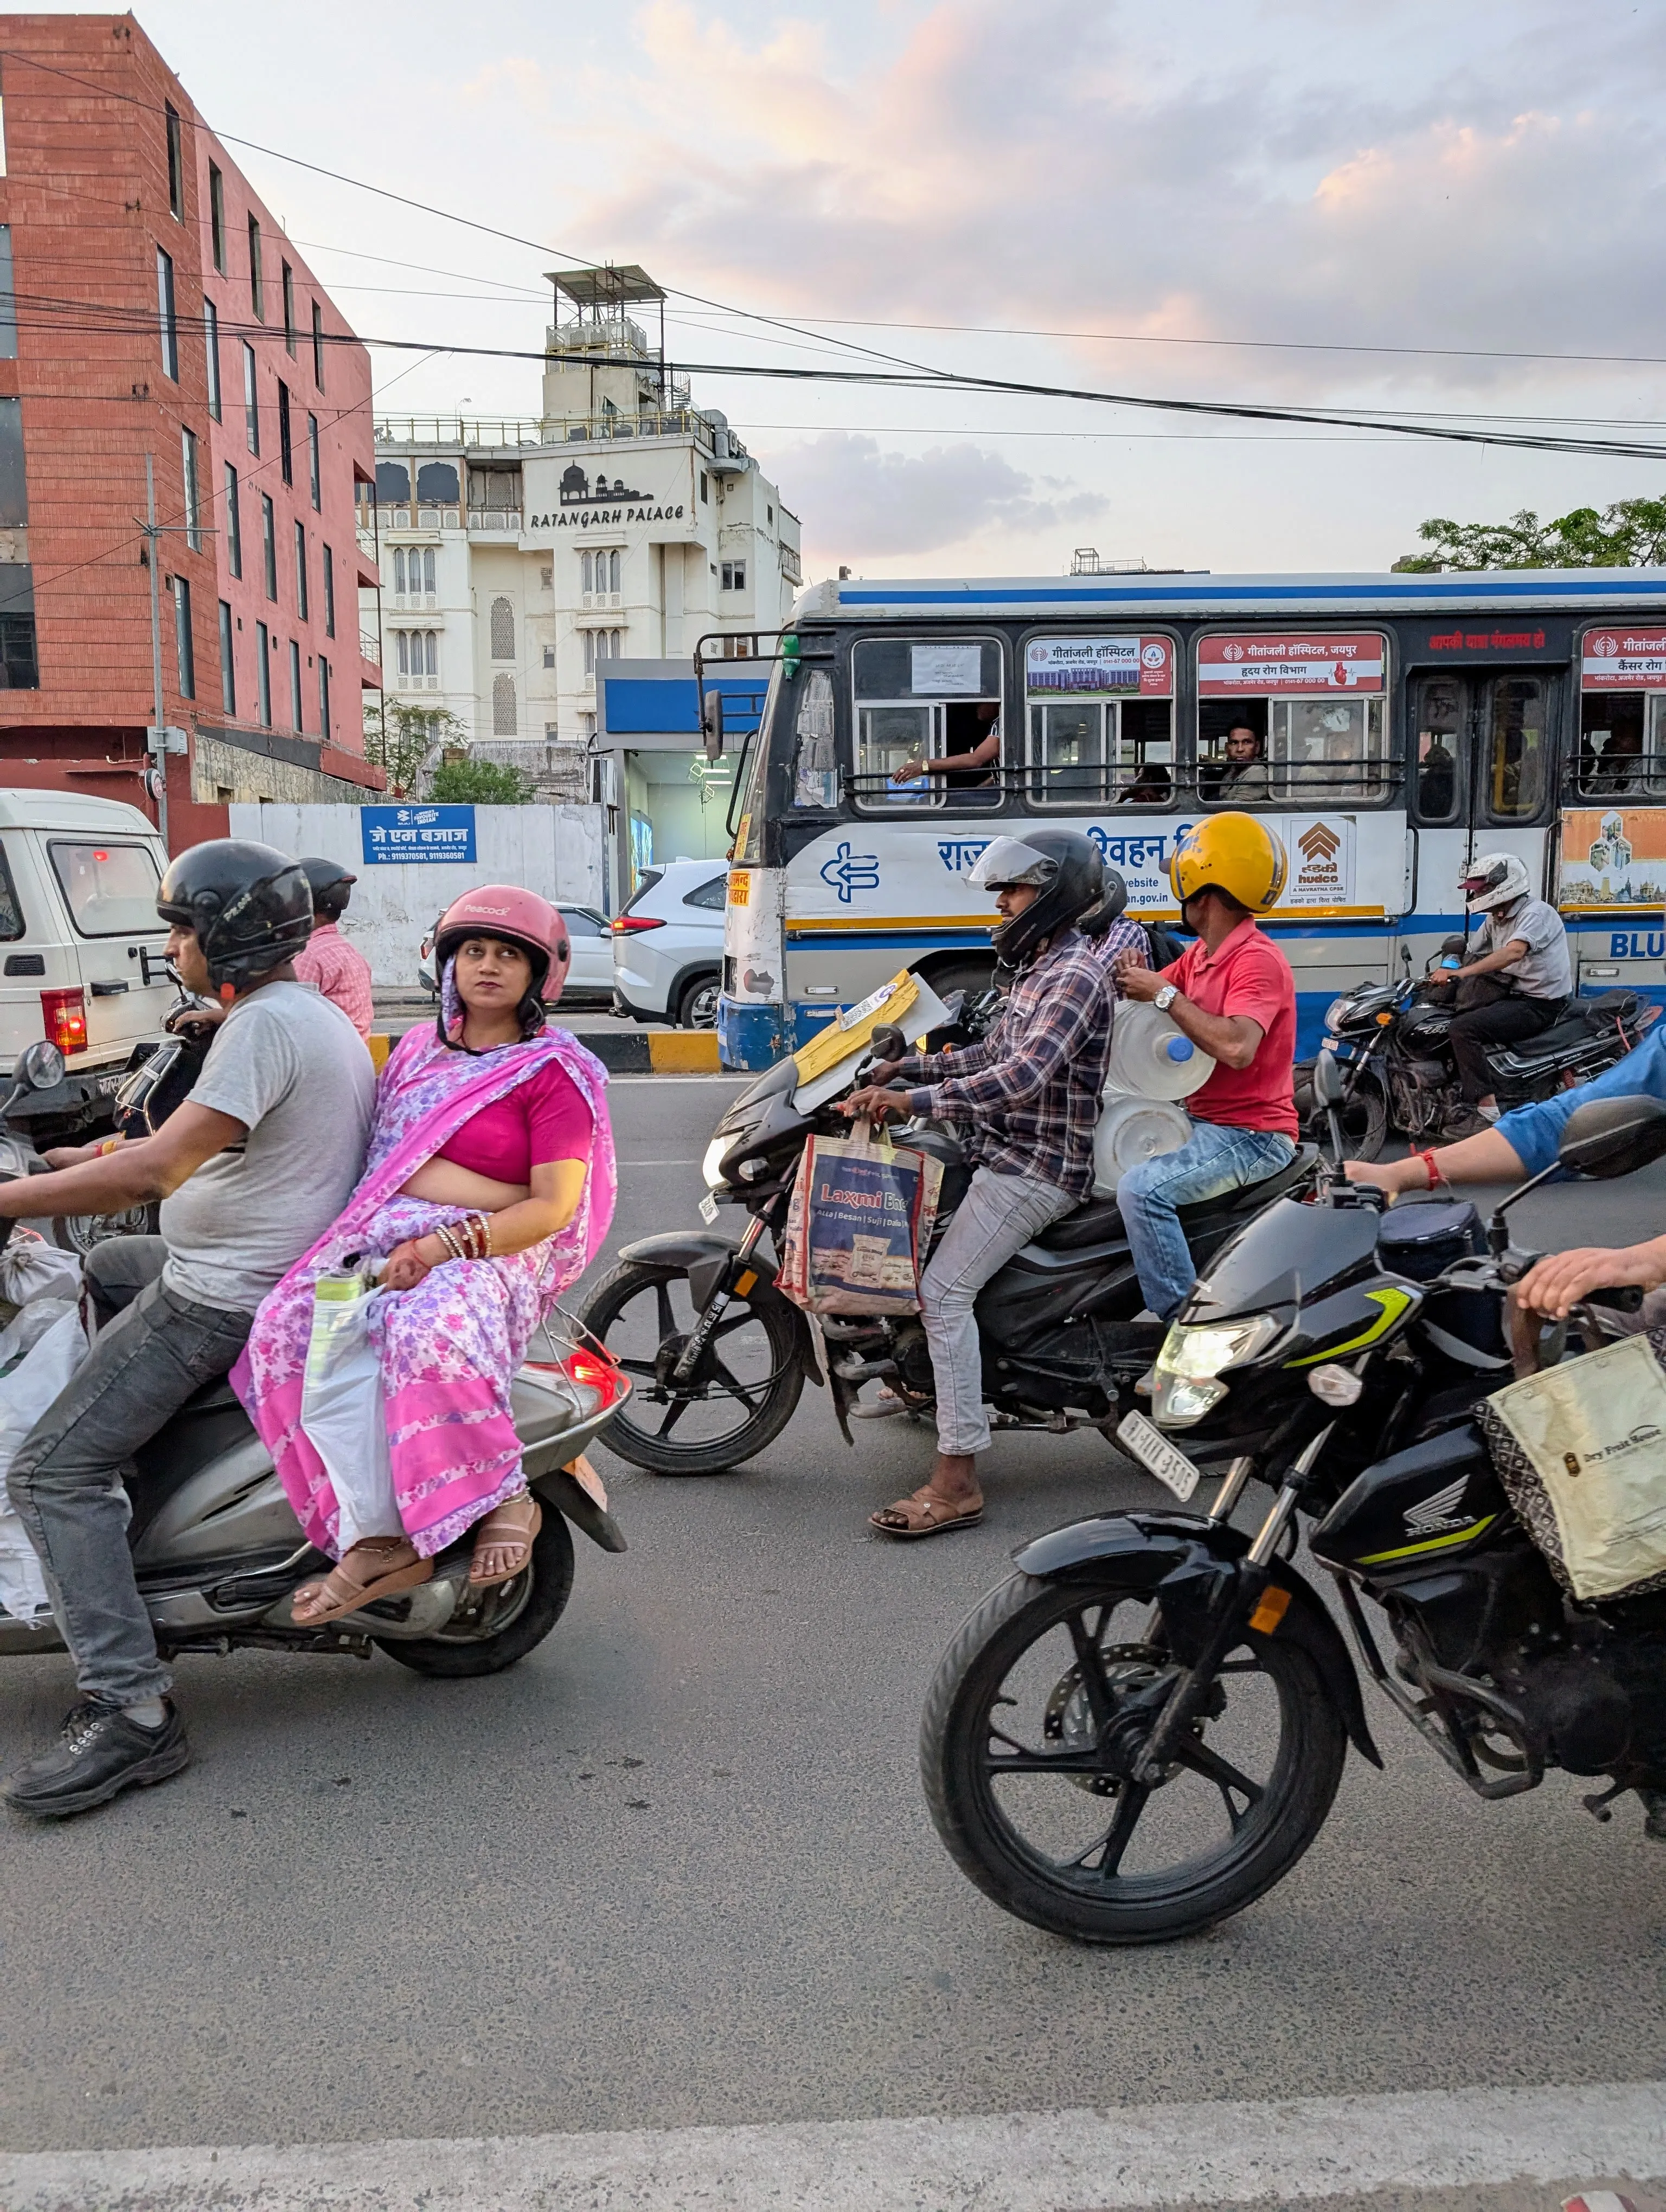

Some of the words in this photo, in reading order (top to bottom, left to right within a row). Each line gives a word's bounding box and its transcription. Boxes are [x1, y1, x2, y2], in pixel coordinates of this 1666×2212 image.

[531, 509, 621, 528] RATANGARH
[627, 505, 683, 522] PALACE
[1052, 646, 1093, 658] गीतांजली
[1095, 645, 1135, 658] हॉस्पिटल
[1247, 644, 1285, 656] गीतांजली
[1289, 644, 1328, 656] हॉस्पिटल,
[1330, 645, 1357, 655] जयपुर
[1241, 666, 1261, 677] हृदय
[1263, 665, 1278, 674] रोग
[1279, 664, 1308, 675] विभाग
[1618, 659, 1643, 671] कैंसर
[1645, 659, 1663, 671] रोग
[414, 812, 439, 821] FAVOURITE
[369, 826, 387, 843] जे
[389, 829, 418, 843] एम
[420, 828, 469, 842] बजाज
[1087, 826, 1167, 868] रिवहन
[392, 853, 428, 861] 9119370581,
[1298, 874, 1338, 883] hudco
[1126, 893, 1168, 905] an.gov.in
[821, 1184, 883, 1210] Laxmi
[838, 1212, 862, 1222] Besan
[867, 1217, 883, 1226] Suji
[1584, 1450, 1604, 1462] Dry
[1605, 1440, 1631, 1455] Fruit
[1404, 1516, 1478, 1538] HONDA
